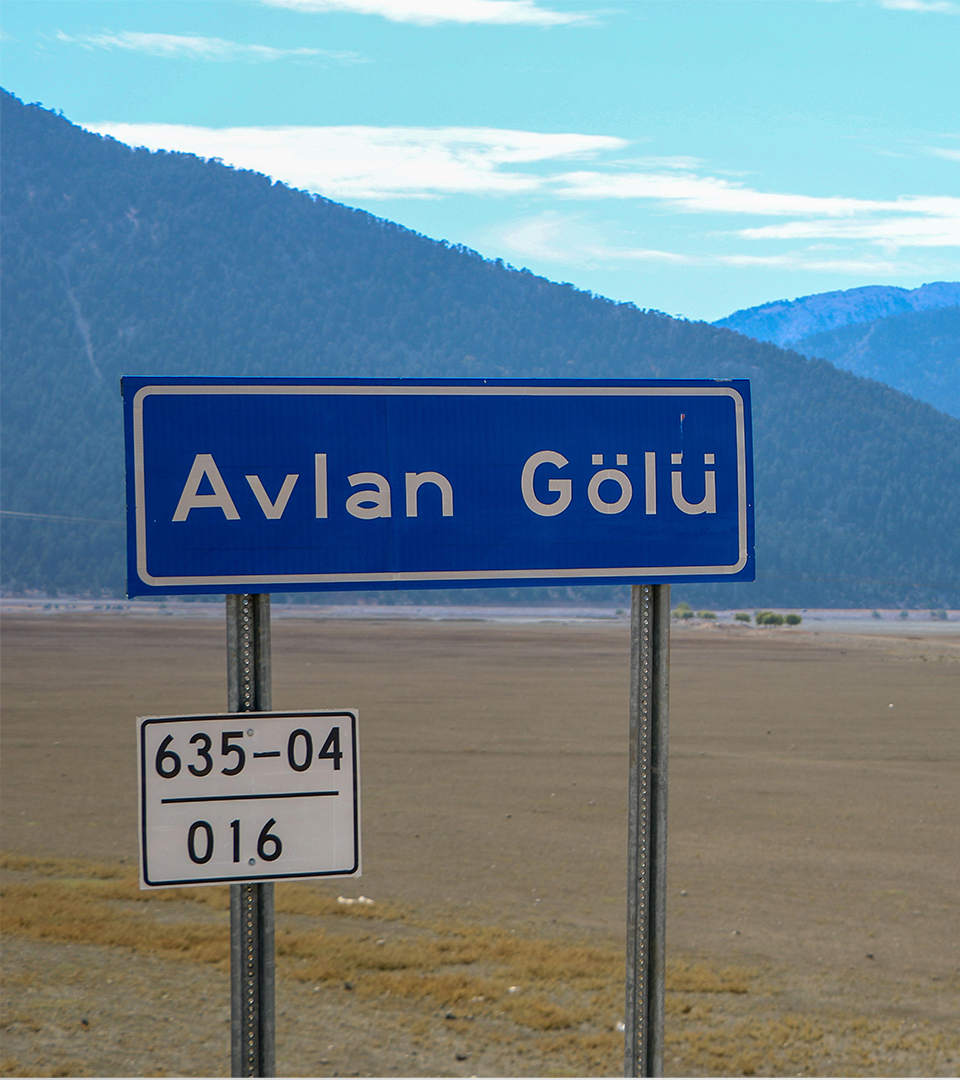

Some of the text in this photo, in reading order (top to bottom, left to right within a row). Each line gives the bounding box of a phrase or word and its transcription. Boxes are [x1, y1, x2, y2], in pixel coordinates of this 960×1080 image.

[171, 450, 718, 522] Avlan Gölü
[154, 726, 344, 780] 635-04
[187, 817, 283, 865] 016
